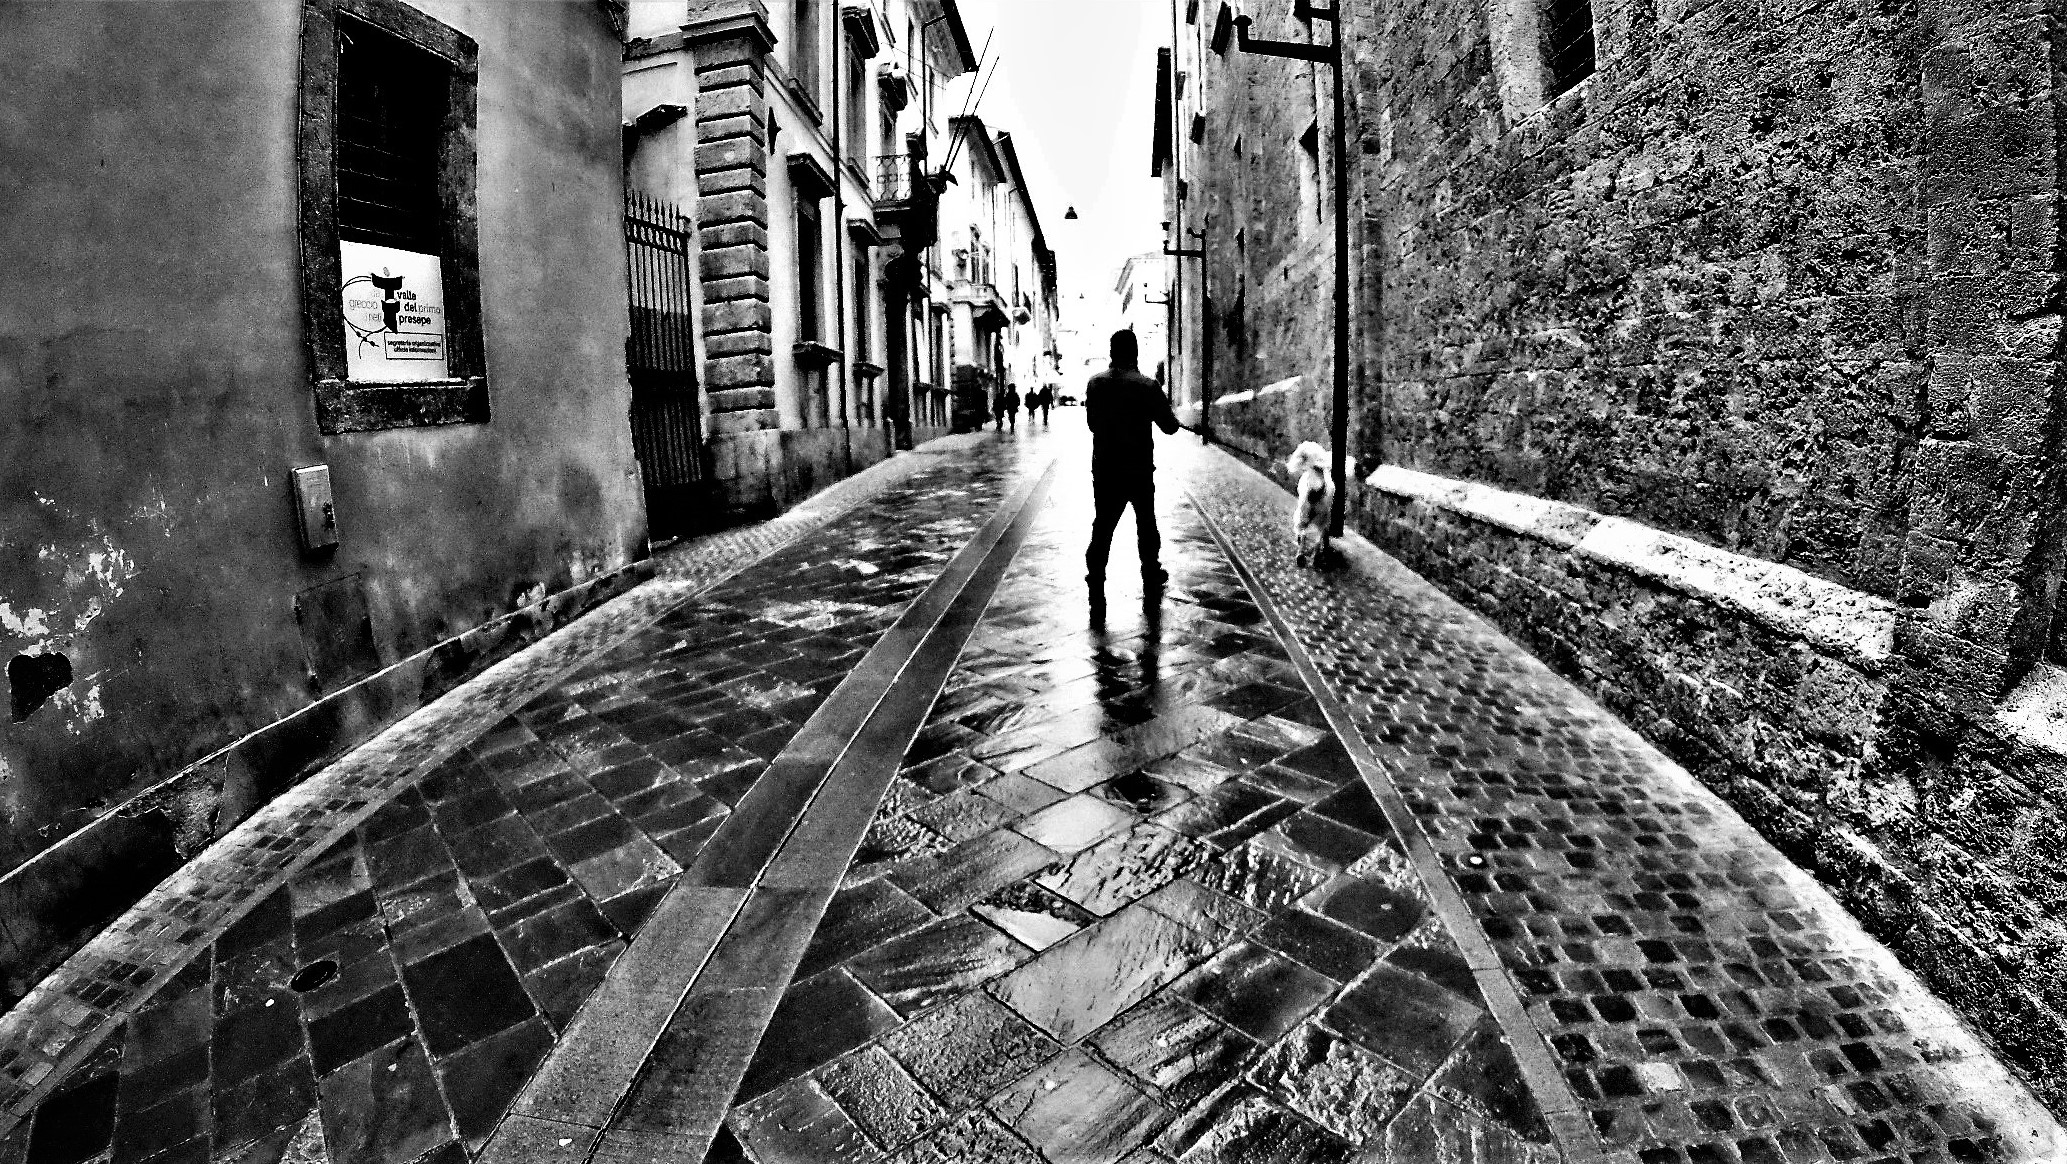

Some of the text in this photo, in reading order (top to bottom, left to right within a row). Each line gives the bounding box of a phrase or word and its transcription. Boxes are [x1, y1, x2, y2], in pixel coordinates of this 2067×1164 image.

[404, 302, 441, 315] del primo
[399, 315, 431, 325] presepe
